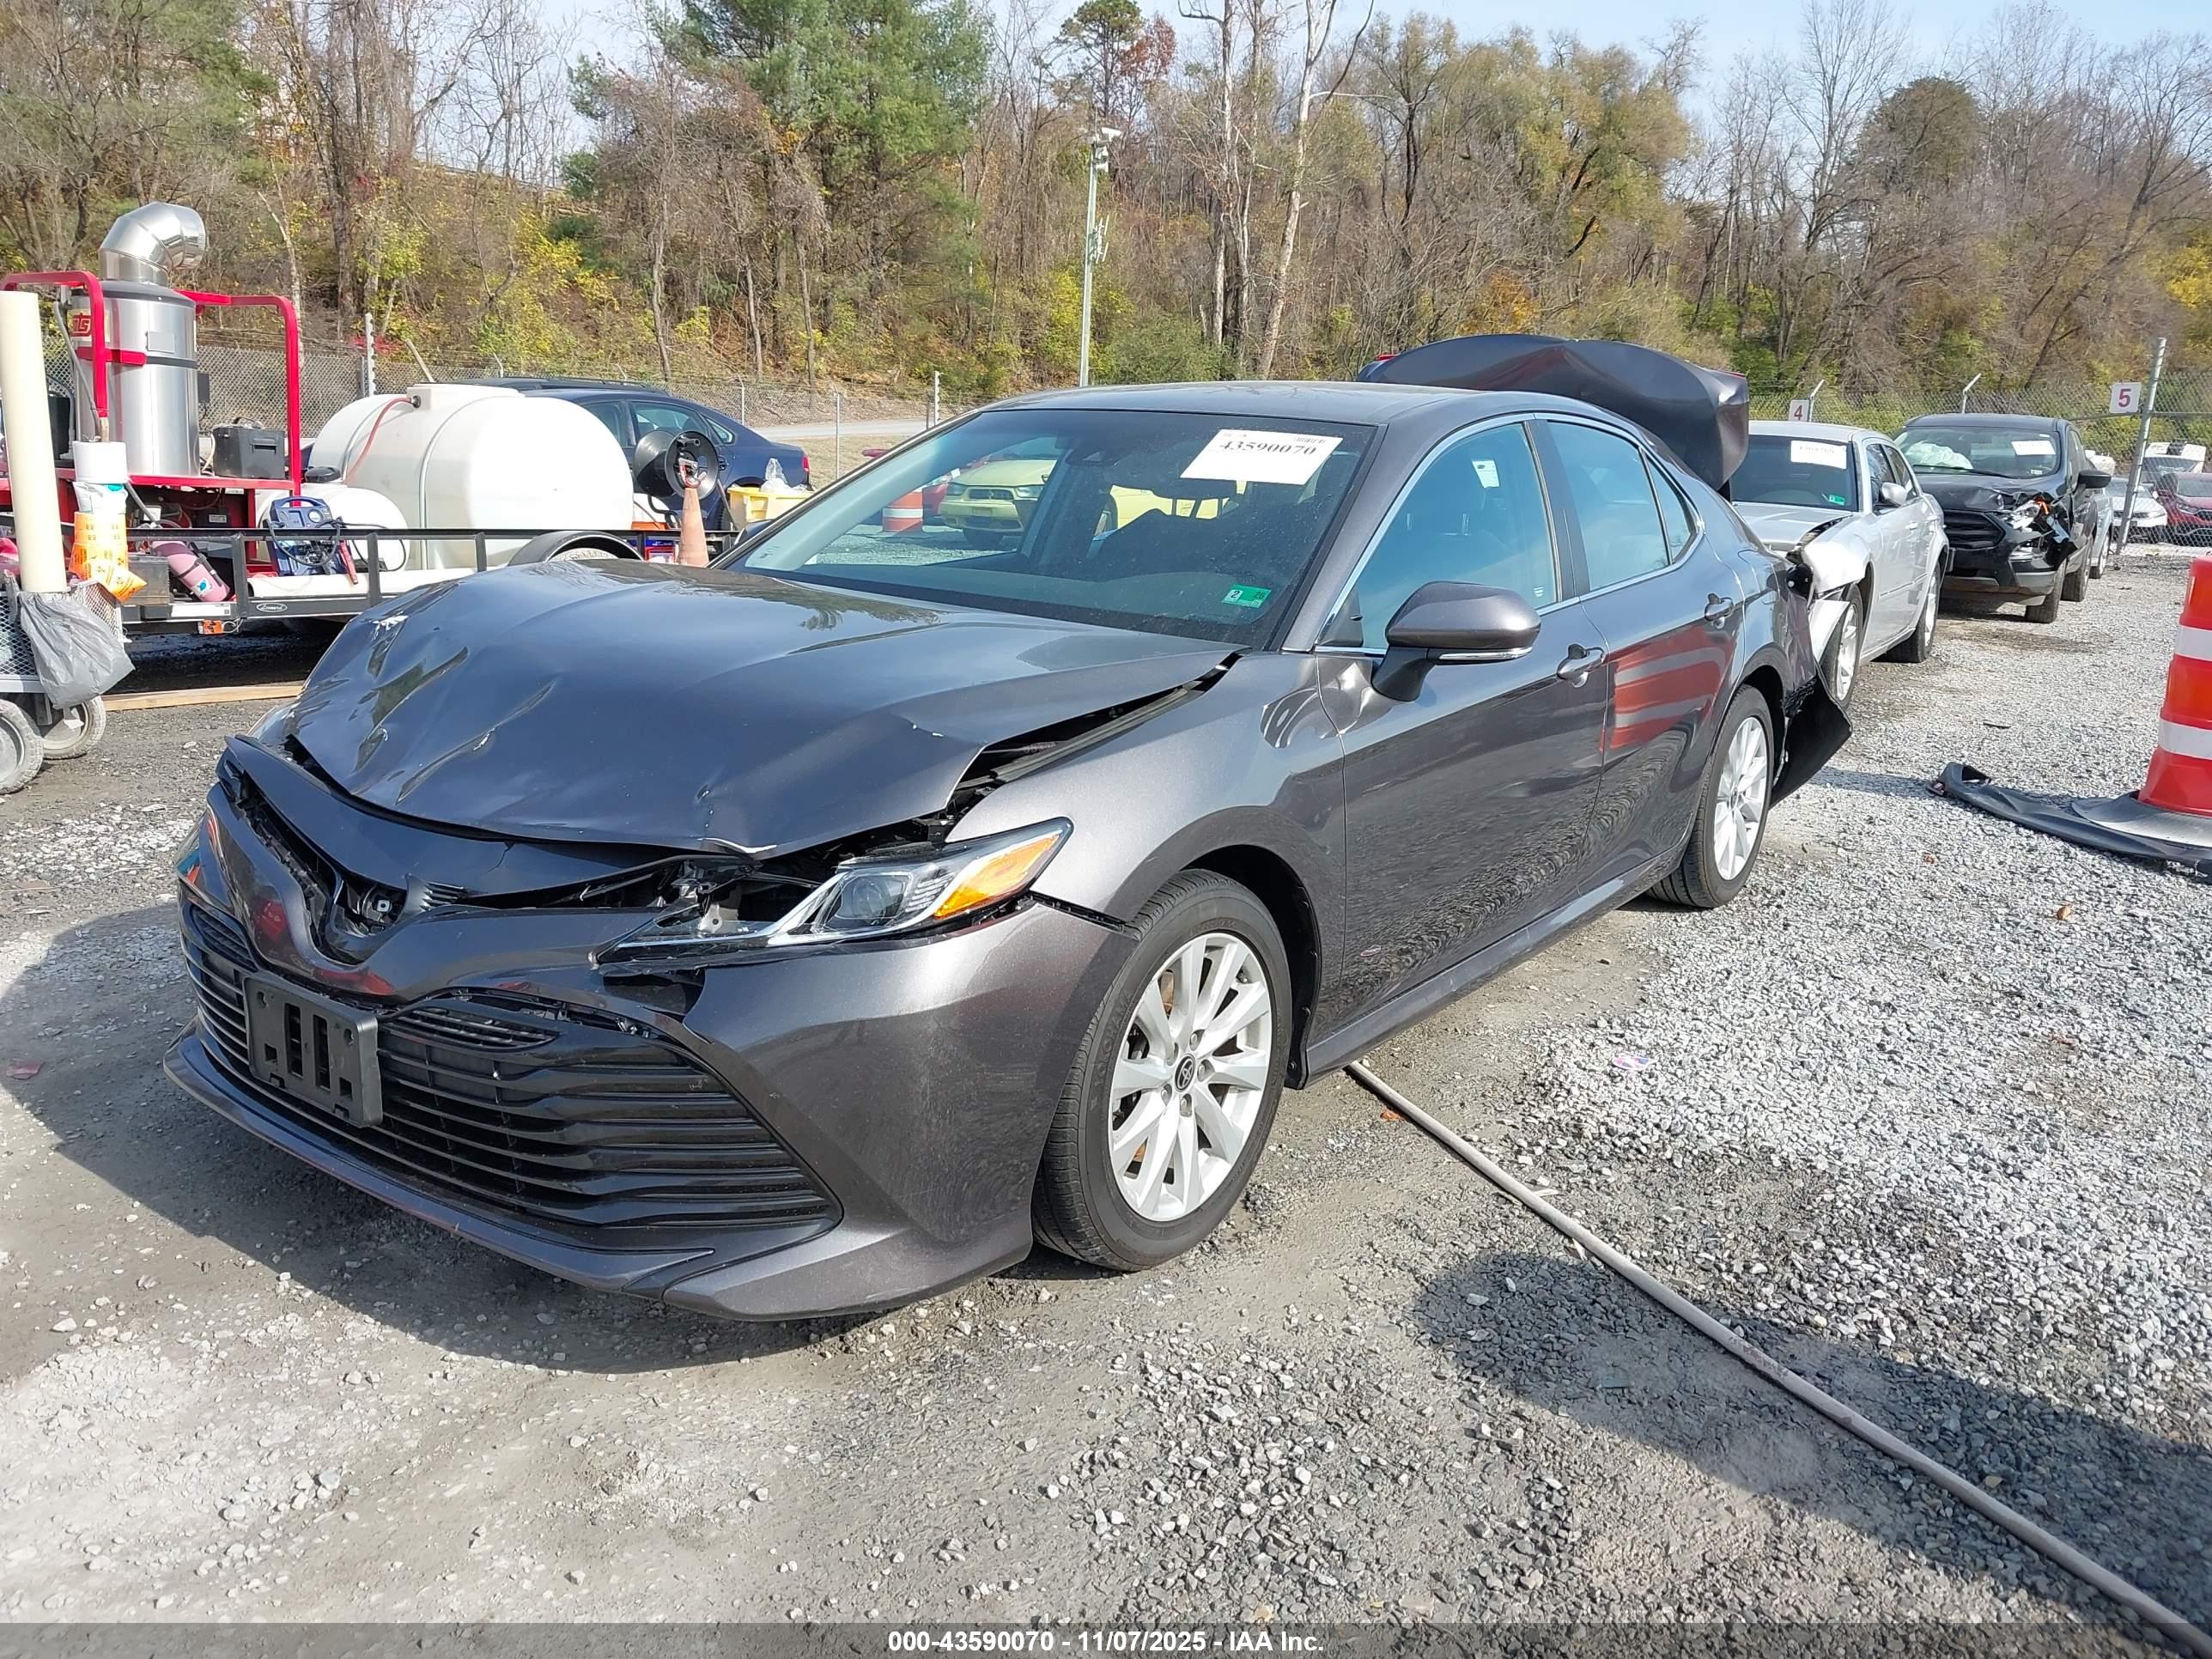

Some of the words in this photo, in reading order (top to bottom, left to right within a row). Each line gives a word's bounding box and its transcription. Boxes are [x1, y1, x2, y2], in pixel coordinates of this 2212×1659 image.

[2118, 388, 2131, 407] 5
[1794, 404, 1803, 421] 4
[1220, 441, 1317, 455] 43590070
[1231, 590, 1240, 599] 2
